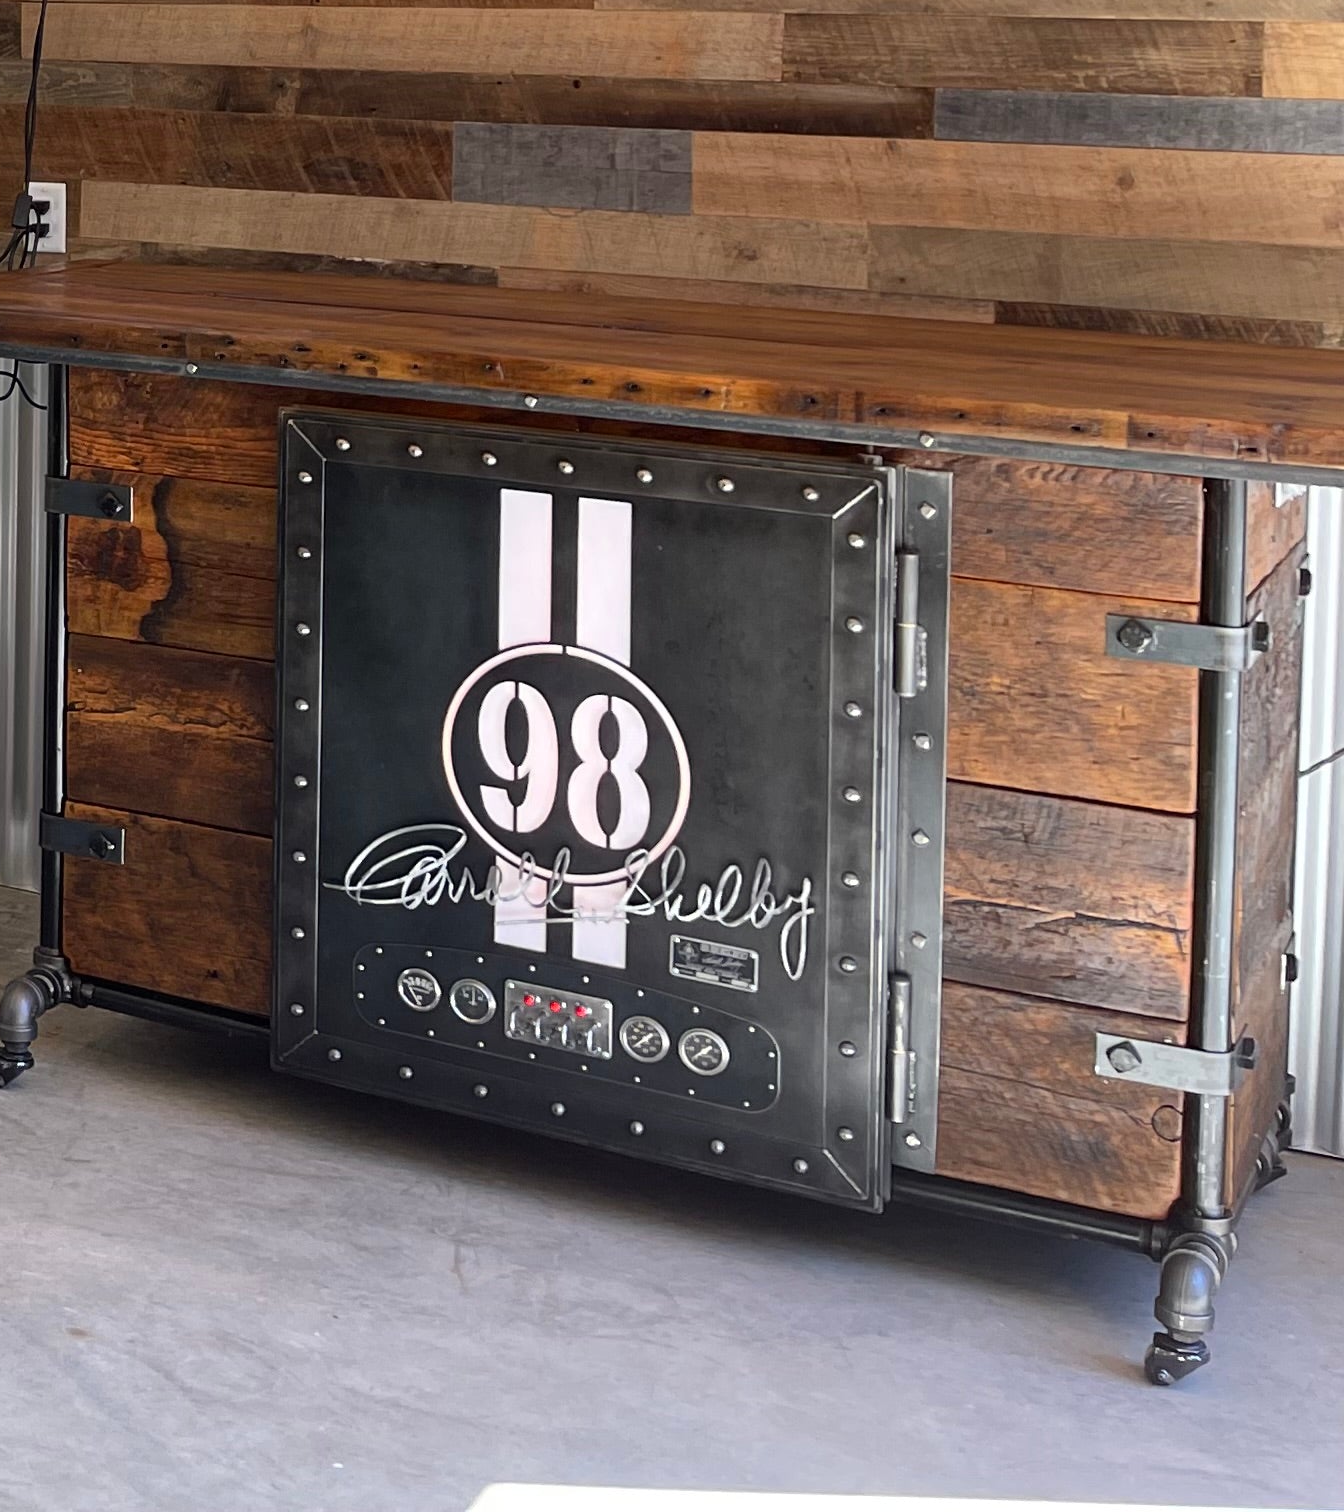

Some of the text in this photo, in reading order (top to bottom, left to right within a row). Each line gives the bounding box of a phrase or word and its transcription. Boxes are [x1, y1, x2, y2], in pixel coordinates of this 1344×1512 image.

[476, 680, 650, 852] 98
[322, 824, 815, 980] Carroll Shelby
